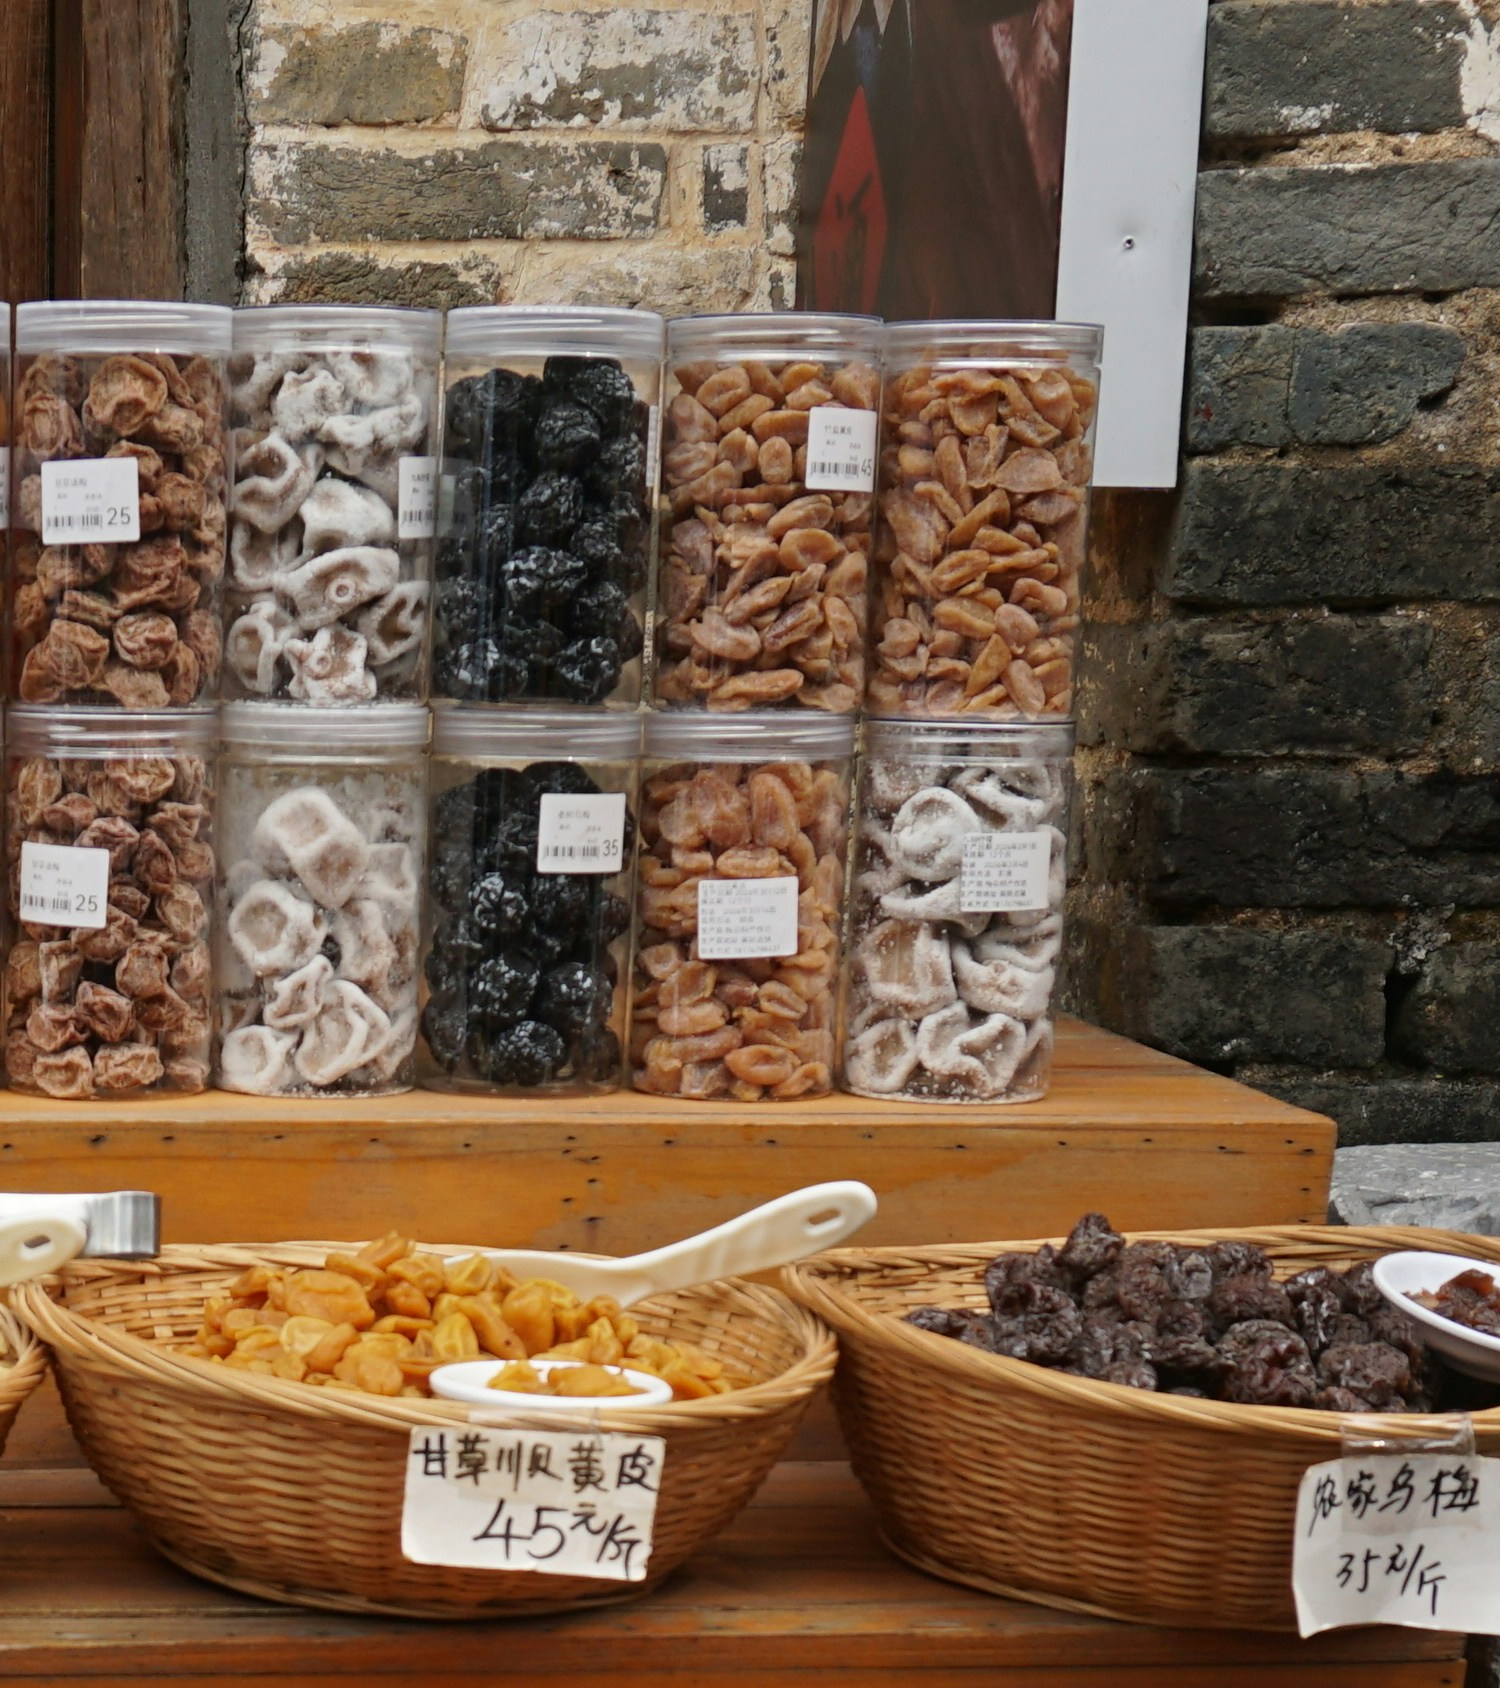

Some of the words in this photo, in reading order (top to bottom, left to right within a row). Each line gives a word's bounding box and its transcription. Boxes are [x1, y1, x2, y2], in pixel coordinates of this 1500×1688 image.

[860, 457, 873, 477] 45
[106, 506, 131, 526] 25
[602, 838, 619, 857] 35
[75, 893, 99, 912] 25
[472, 1497, 643, 1579] 45元/斤
